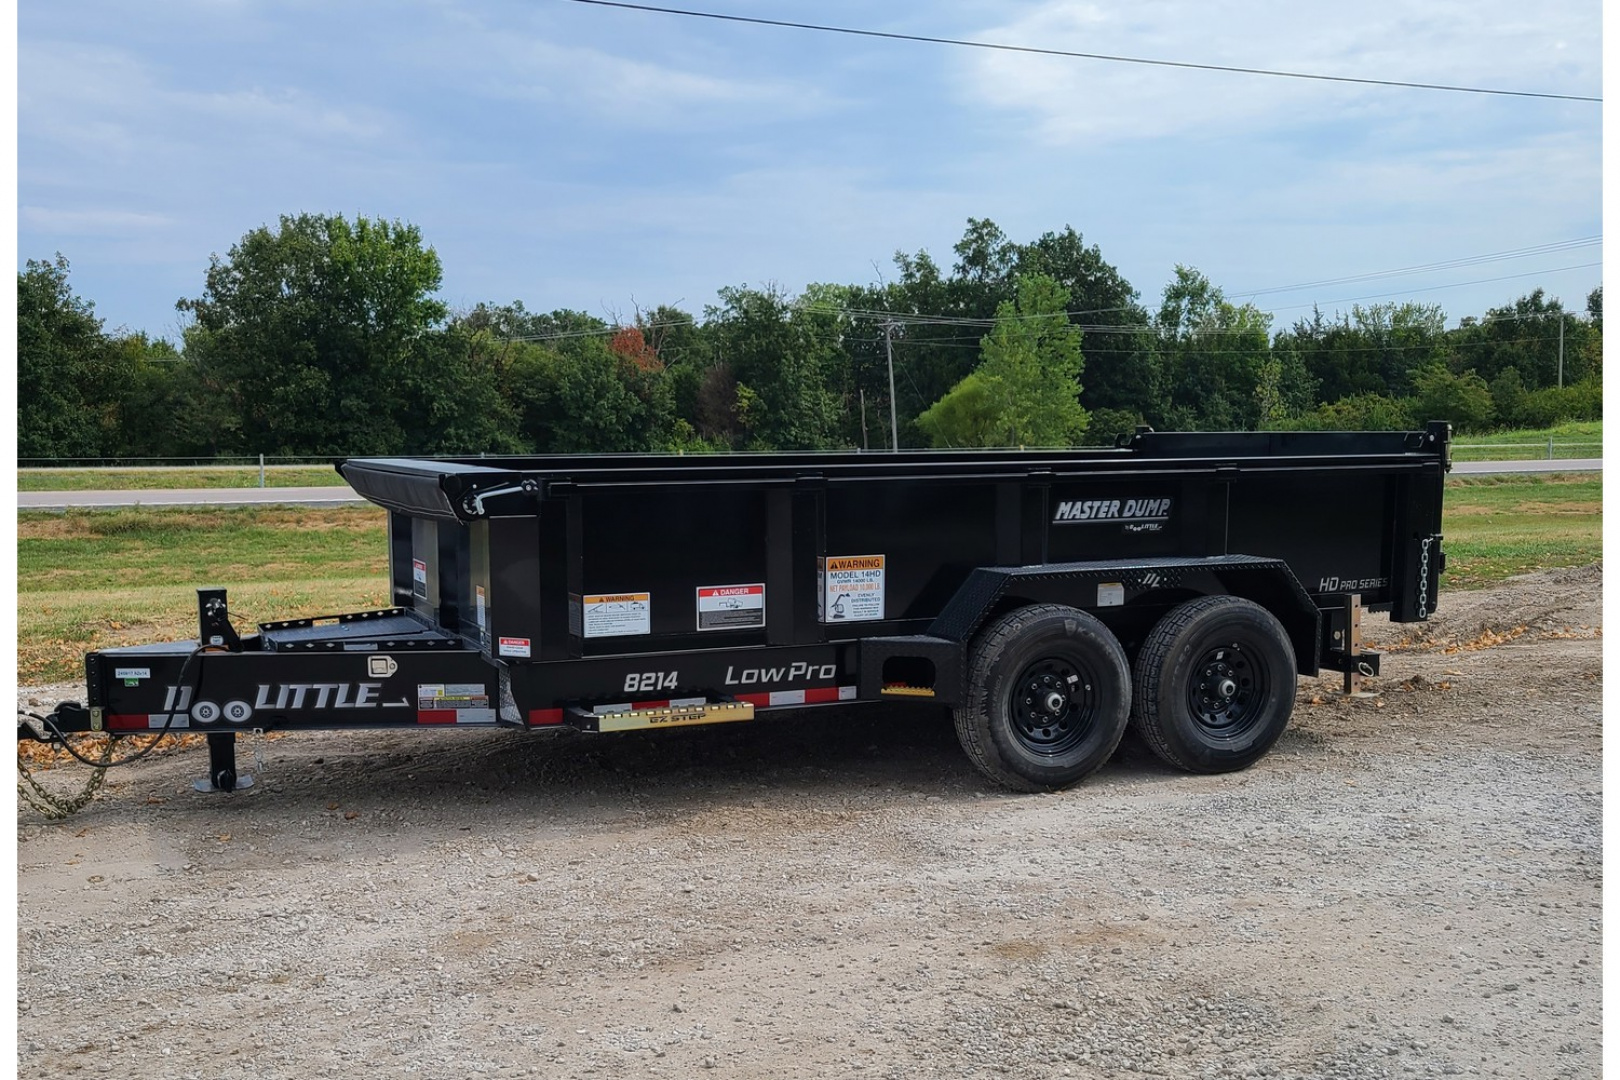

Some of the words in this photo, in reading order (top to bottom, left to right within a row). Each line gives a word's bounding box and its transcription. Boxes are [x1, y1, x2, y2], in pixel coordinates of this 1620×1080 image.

[1055, 500, 1120, 520] MASTER
[839, 559, 880, 569] WARNING
[831, 571, 859, 579] MODEL
[1319, 576, 1339, 592] HD
[1340, 580, 1358, 590] PRO
[1359, 578, 1388, 588] SERIES
[720, 588, 749, 596] DANGER
[606, 595, 635, 603] WARNING
[624, 671, 678, 692] 8214
[671, 713, 706, 722] STEP
